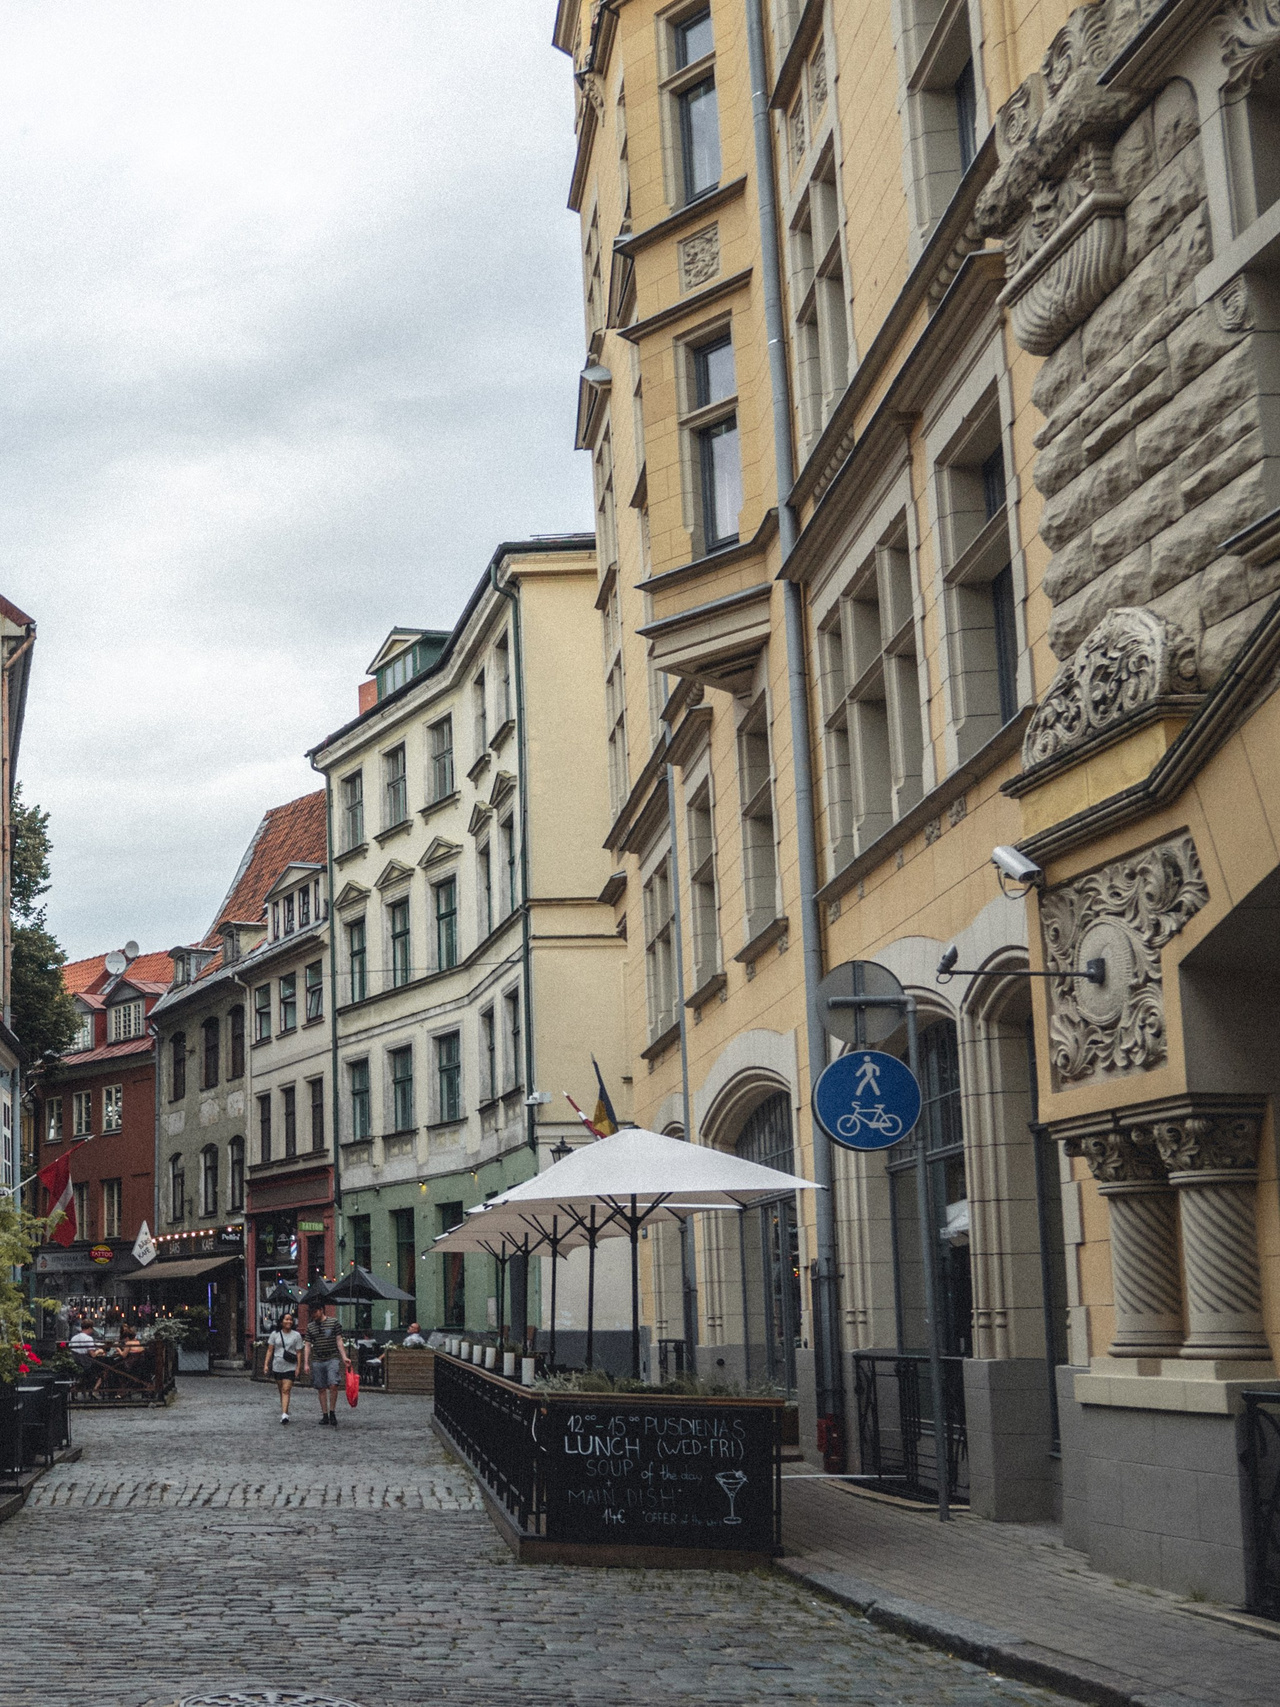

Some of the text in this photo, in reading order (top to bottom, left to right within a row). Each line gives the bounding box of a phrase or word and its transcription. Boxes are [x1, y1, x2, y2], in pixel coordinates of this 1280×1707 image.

[302, 1222, 324, 1231] TATTOO
[644, 1416, 747, 1440] PUSDIENAS
[564, 1435, 745, 1461] LUNCH (WED-FRI)
[586, 1459, 704, 1485] SOUP of the day
[568, 1489, 616, 1506] MAIN
[602, 1508, 626, 1525] 14€
